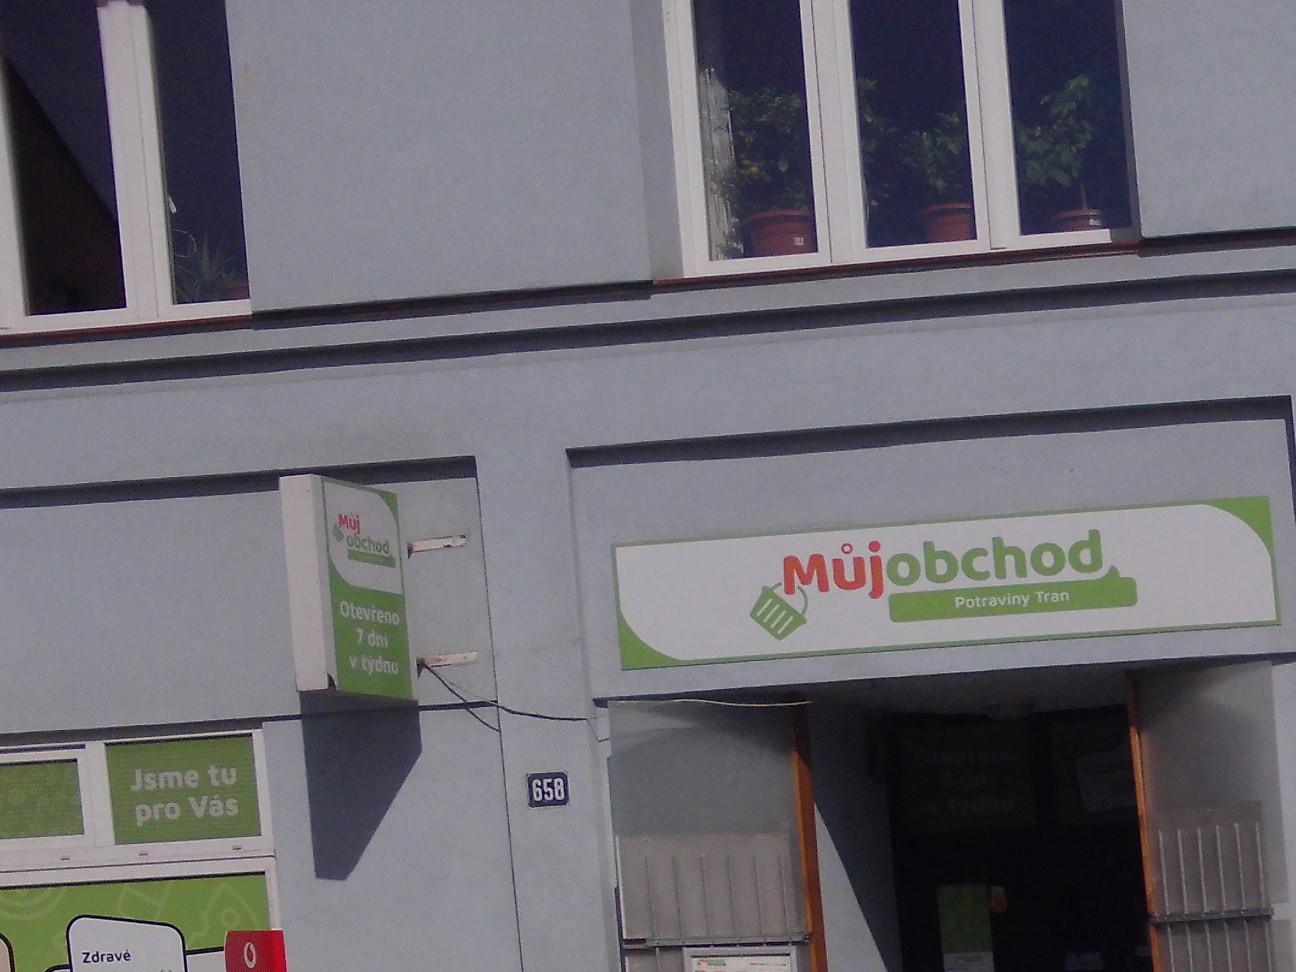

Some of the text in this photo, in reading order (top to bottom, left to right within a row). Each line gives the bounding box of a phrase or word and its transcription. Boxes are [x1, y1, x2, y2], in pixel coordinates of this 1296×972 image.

[347, 534, 390, 555] obchod
[954, 590, 1071, 609] Potraviny Tran
[339, 601, 400, 625] Otevřeno
[356, 628, 363, 646] 7
[349, 657, 399, 676] v týdnu
[131, 765, 238, 792] Jsme tu
[532, 777, 565, 802] 658
[135, 793, 239, 826] pro Vás
[81, 948, 132, 964] Zdravé
